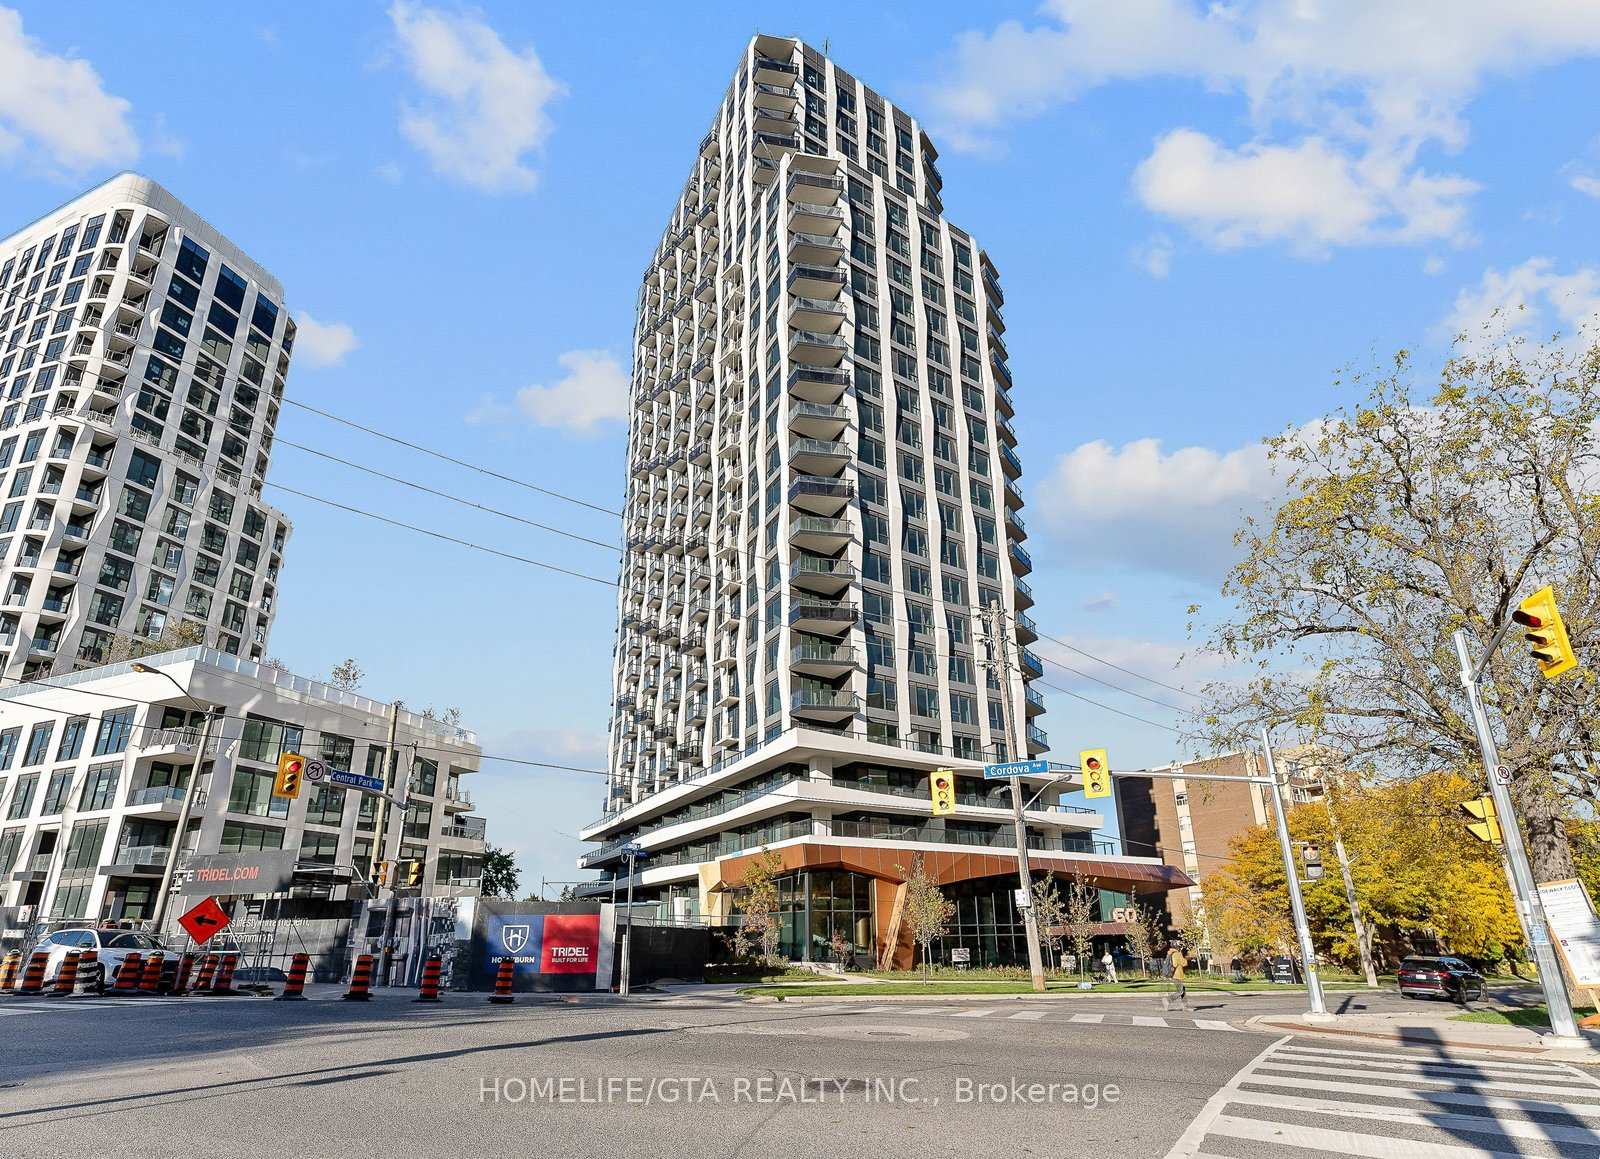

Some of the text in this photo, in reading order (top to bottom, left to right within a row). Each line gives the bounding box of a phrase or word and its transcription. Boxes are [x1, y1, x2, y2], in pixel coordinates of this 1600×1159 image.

[990, 765, 1030, 776] Cordova
[331, 771, 356, 785] Central
[358, 777, 373, 788] Park
[197, 867, 259, 882] TRIDEL.COM
[551, 947, 589, 957] TRIDEL
[492, 956, 535, 964] HOBURN
